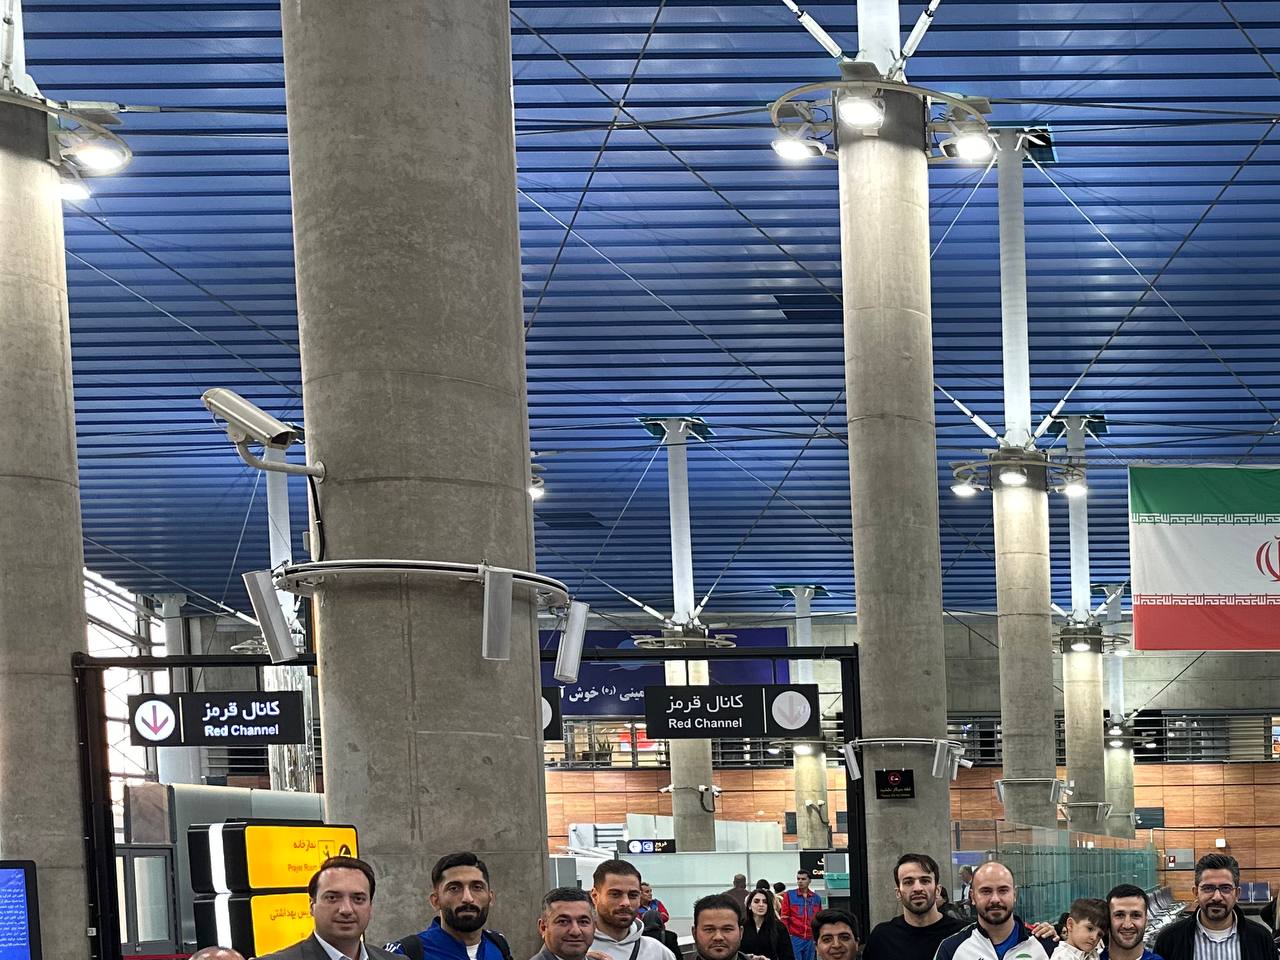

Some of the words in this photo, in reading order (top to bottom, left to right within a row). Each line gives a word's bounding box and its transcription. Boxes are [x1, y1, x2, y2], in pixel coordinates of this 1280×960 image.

[568, 686, 599, 702] خوش
[706, 694, 744, 713] کانال
[201, 702, 238, 722] قرمز
[241, 700, 281, 721] کانال
[665, 695, 702, 714] قرمز
[204, 724, 229, 737] Red
[230, 723, 280, 736] Channel
[668, 718, 692, 729] Red
[694, 717, 743, 729] Channel
